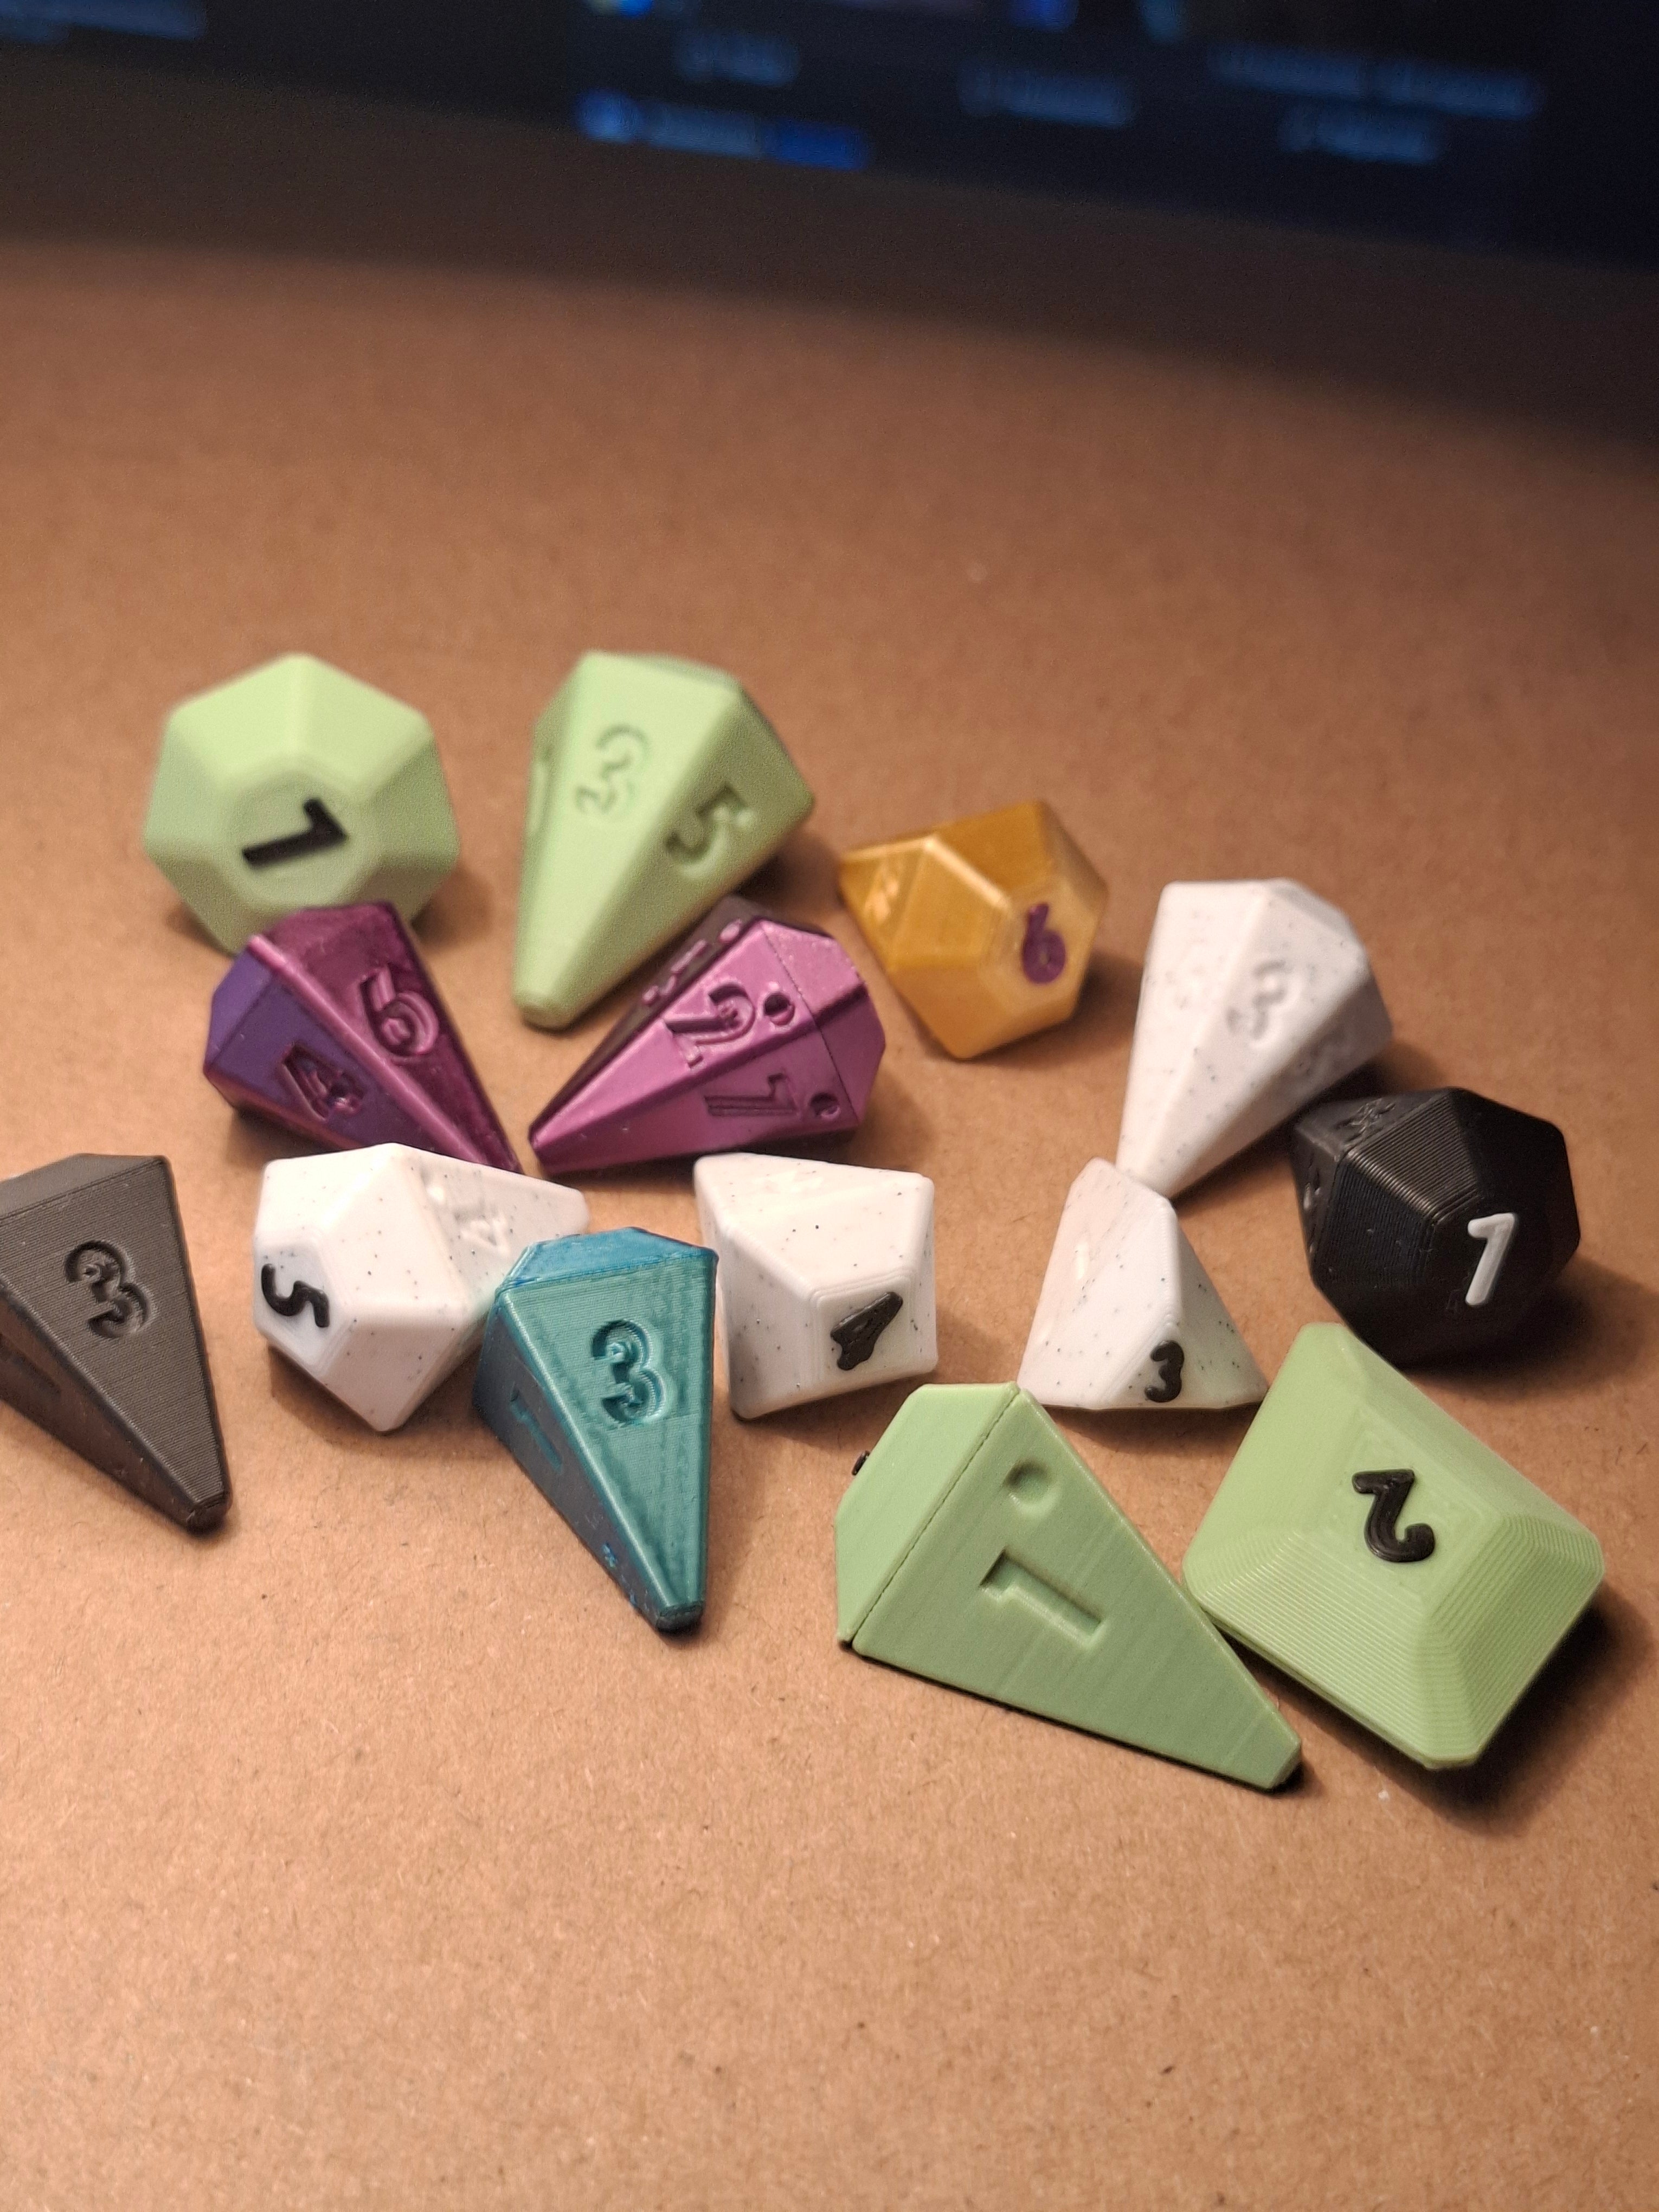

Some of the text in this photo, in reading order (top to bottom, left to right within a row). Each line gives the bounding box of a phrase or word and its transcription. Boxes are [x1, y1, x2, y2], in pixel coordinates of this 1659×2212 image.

[241, 797, 350, 871] 1
[1021, 902, 1066, 985] 6
[359, 964, 439, 1064] 6
[663, 981, 756, 1069] 2
[704, 1072, 799, 1117] 1
[64, 1239, 157, 1338] 3
[261, 1263, 330, 1328] 5
[591, 1319, 669, 1427] 3
[1144, 1339, 1185, 1403] 3
[1352, 1468, 1436, 1564] 2
[978, 1546, 1107, 1648] 1
